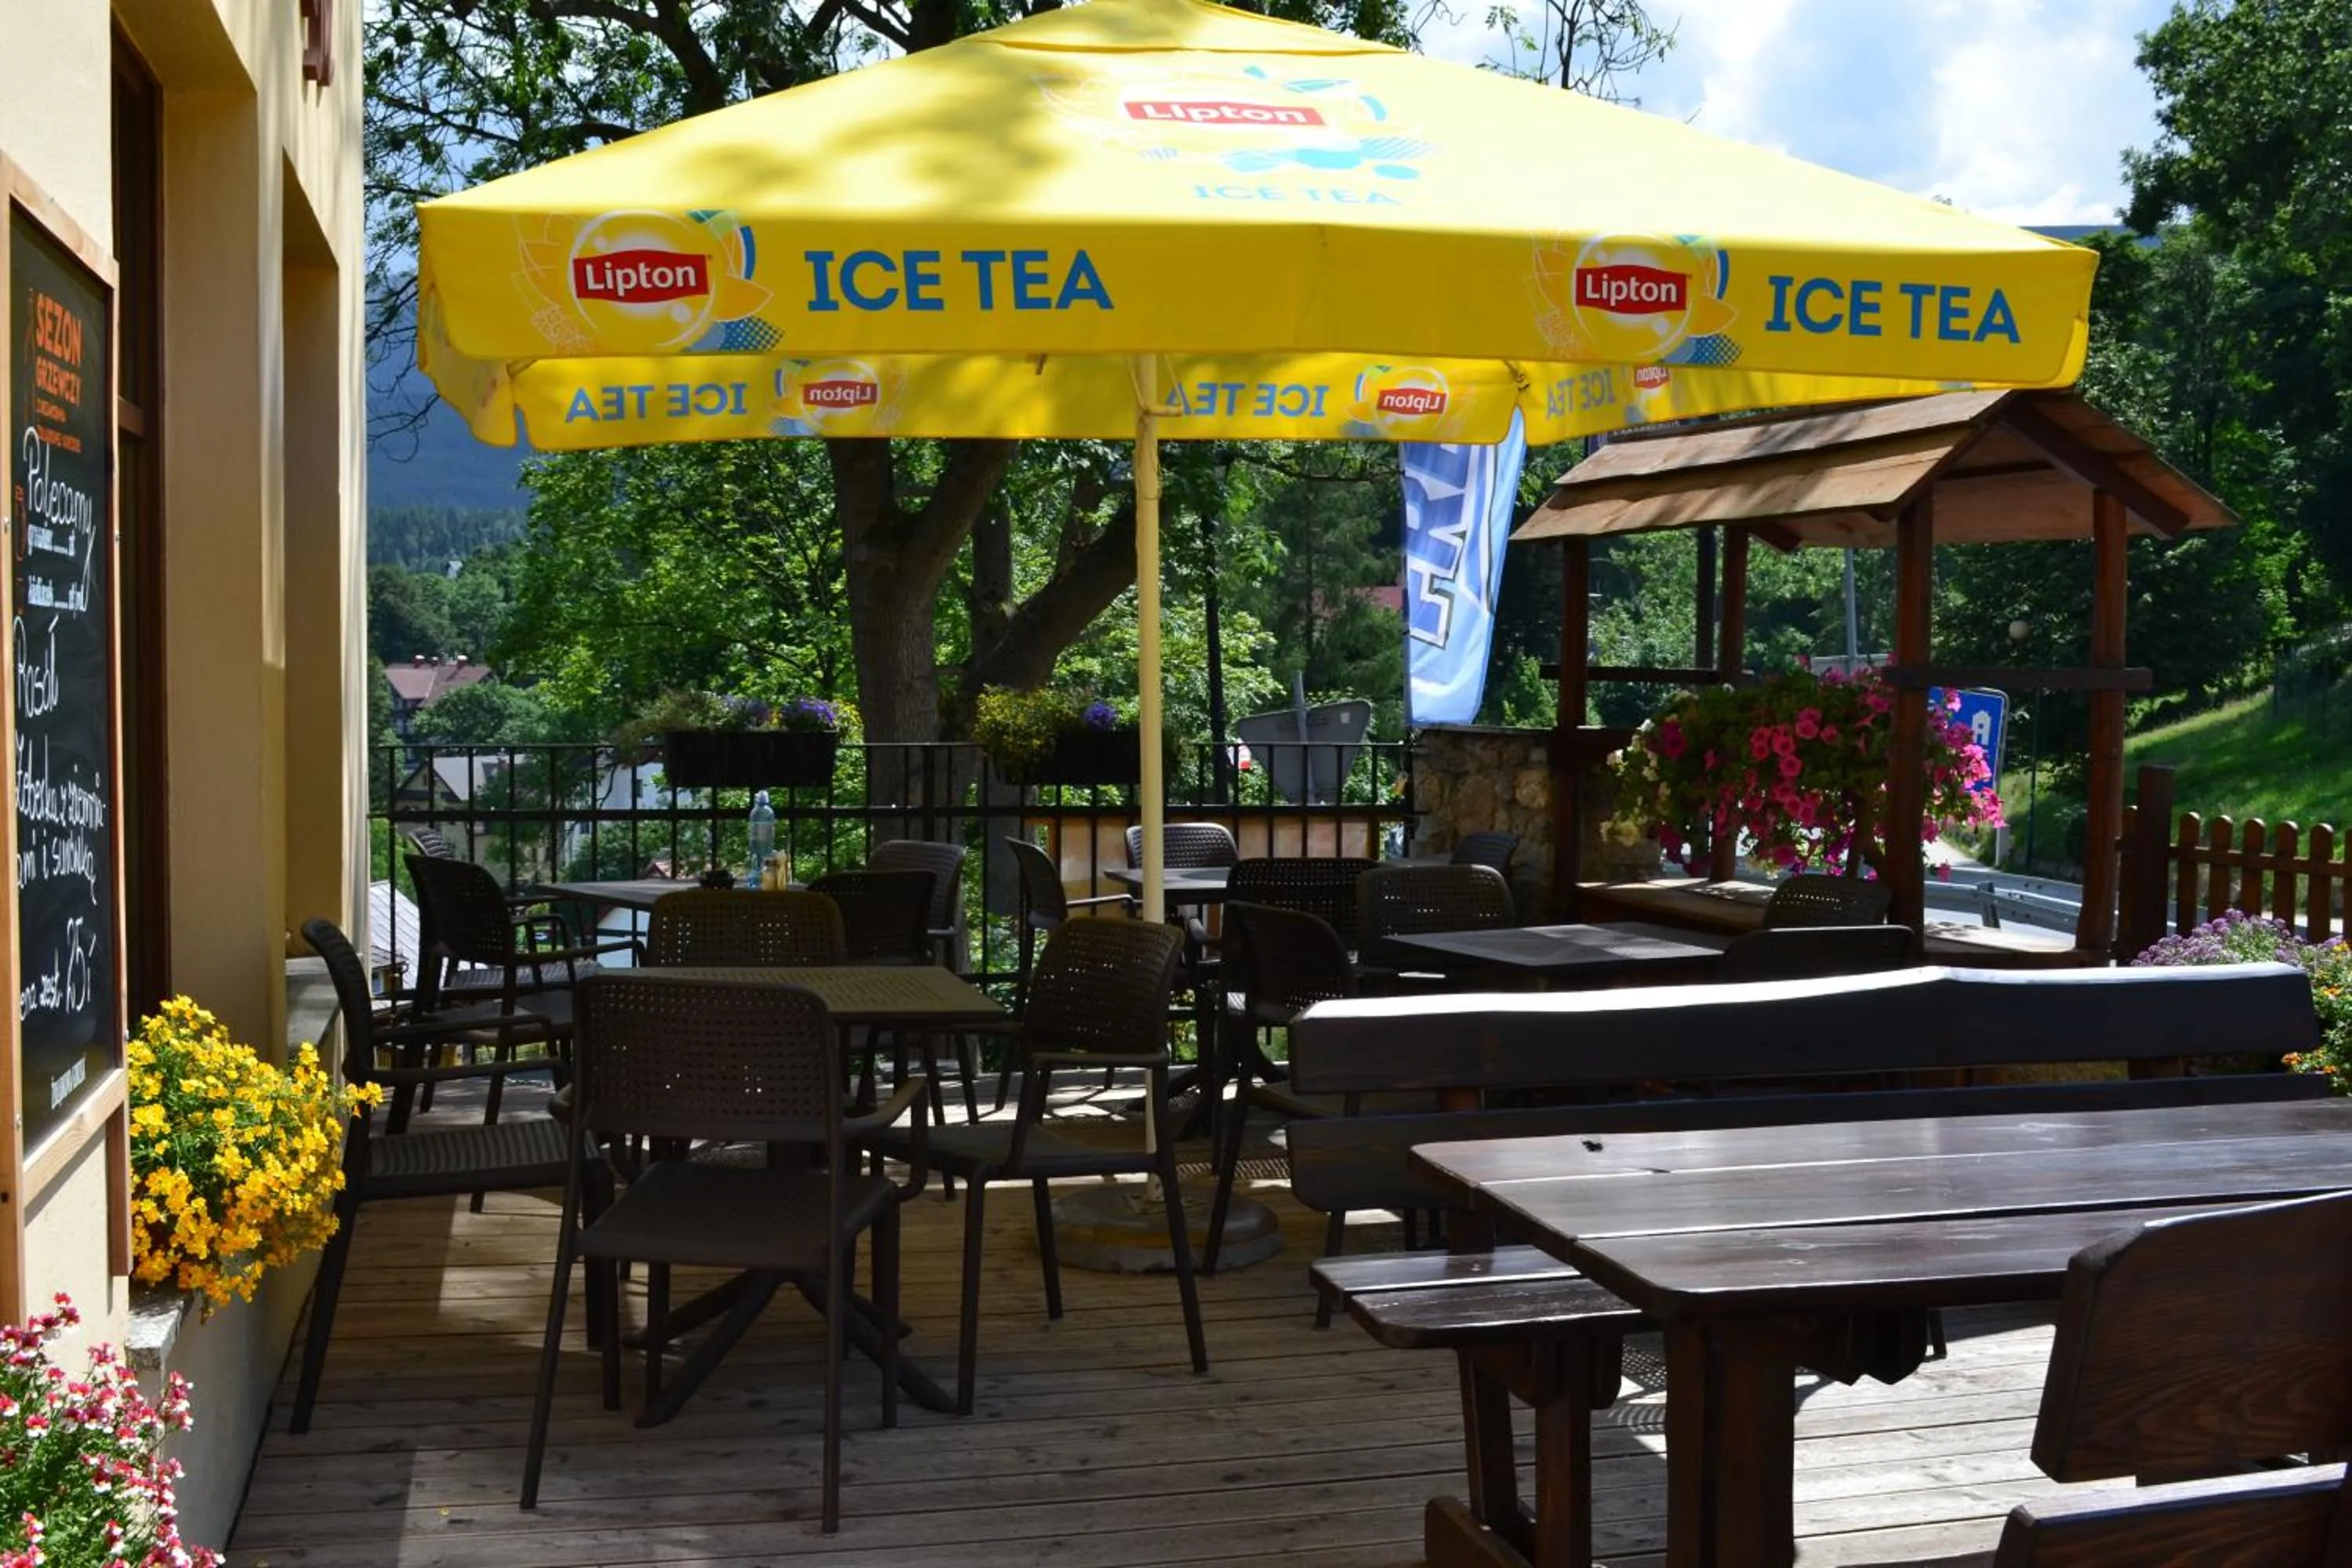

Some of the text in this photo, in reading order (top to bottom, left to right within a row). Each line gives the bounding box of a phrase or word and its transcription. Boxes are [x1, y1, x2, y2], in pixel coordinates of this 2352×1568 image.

[1142, 103, 1308, 123] Lipton
[1193, 184, 1401, 205] ICE TEA
[584, 263, 698, 290] Lipton
[806, 250, 1114, 310] ICE TEA
[1585, 274, 1677, 306] Lipton
[36, 292, 83, 367] SEZON
[1766, 276, 2020, 343] ICE TEA
[24, 426, 96, 612] Polecamy
